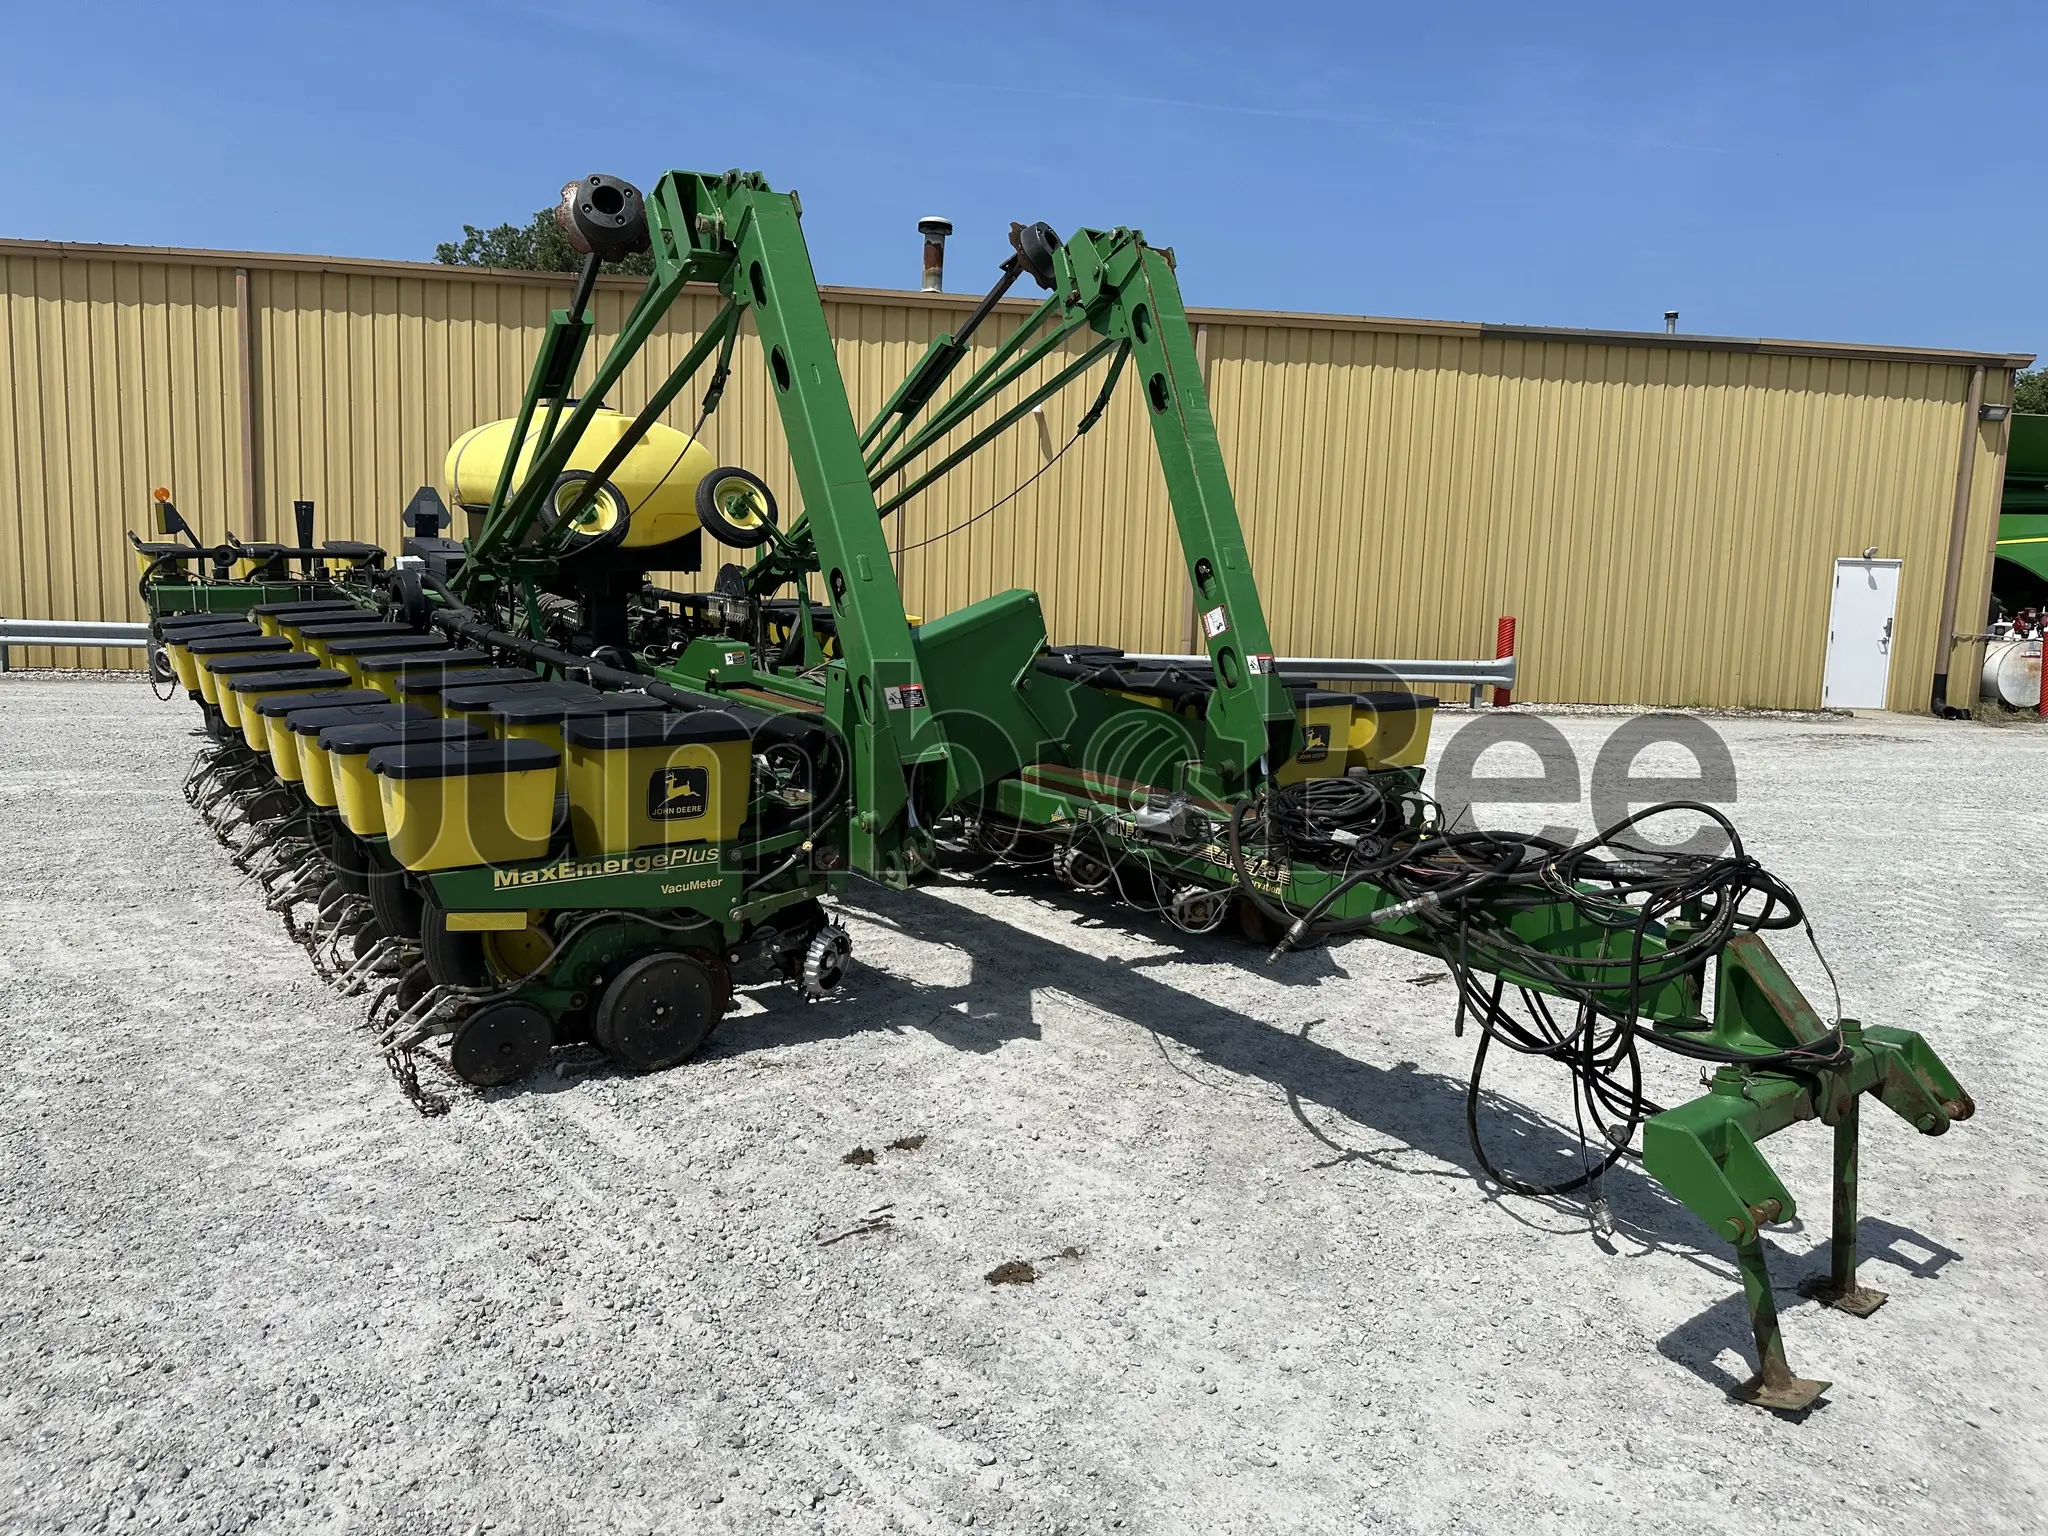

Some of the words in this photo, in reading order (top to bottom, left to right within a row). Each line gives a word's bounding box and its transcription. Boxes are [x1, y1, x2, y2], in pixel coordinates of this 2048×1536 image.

[652, 807, 675, 816] JOHN
[676, 805, 702, 814] DEERE
[494, 847, 720, 888] MaxEmergePlus
[660, 878, 723, 895] VacuMeter
